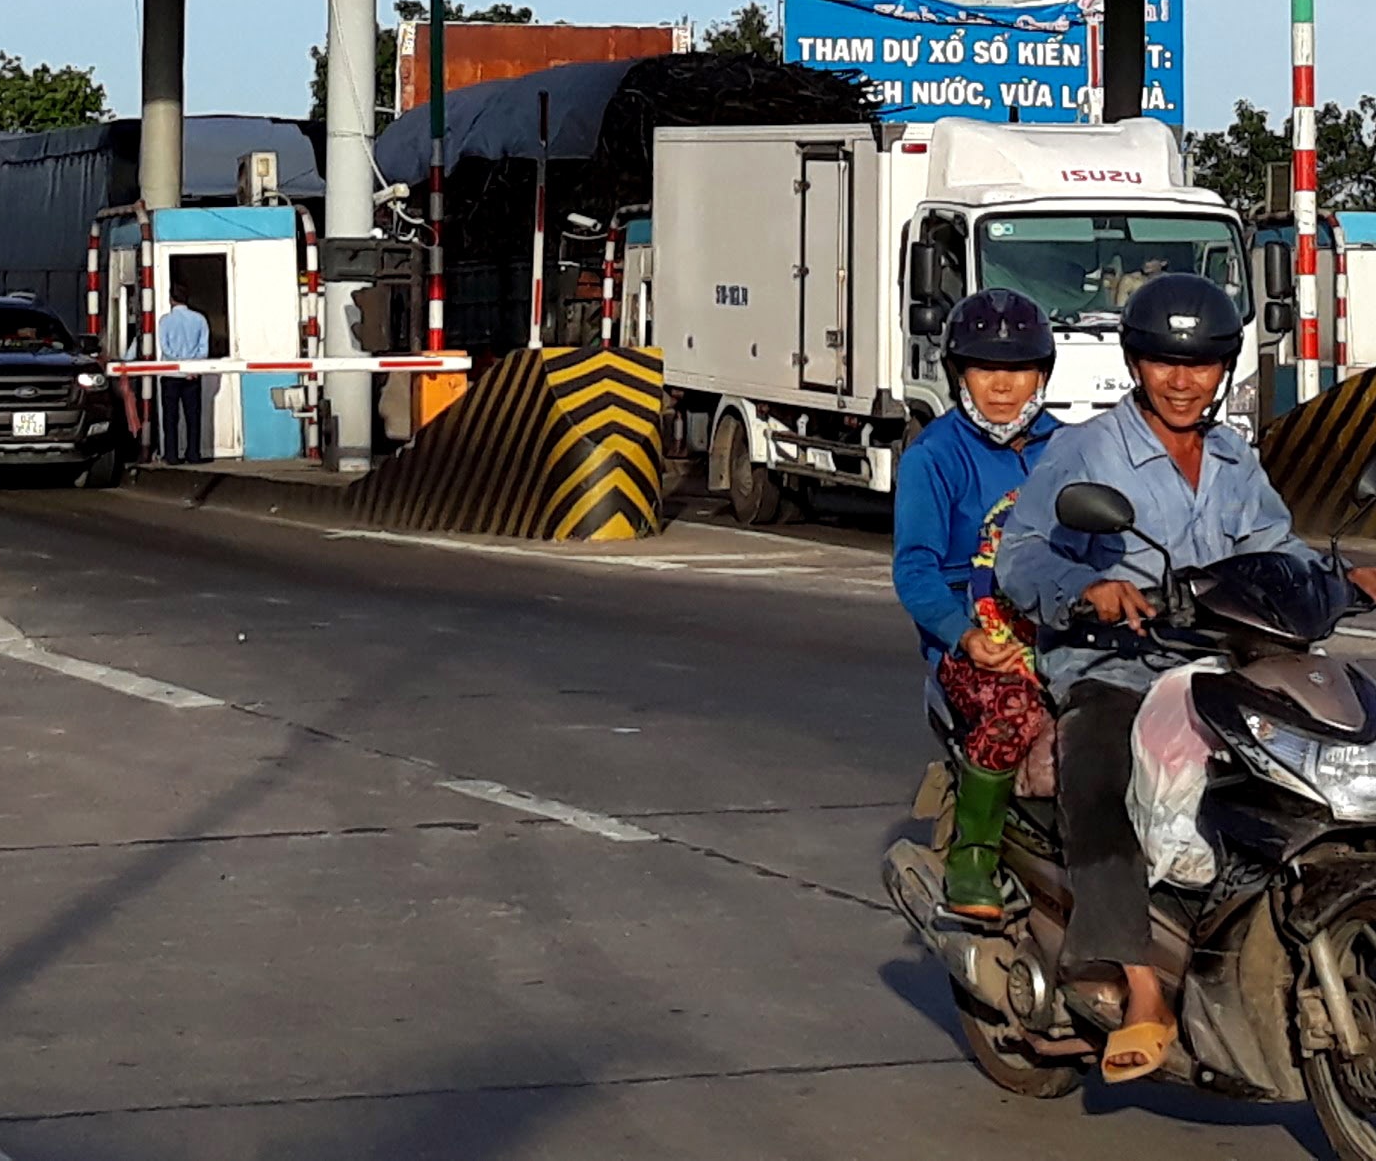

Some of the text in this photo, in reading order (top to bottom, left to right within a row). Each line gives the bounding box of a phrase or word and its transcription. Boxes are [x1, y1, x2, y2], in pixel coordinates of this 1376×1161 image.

[798, 36, 874, 63] THAM
[882, 34, 922, 67] DỰ
[928, 27, 967, 64] XỔ
[972, 31, 1009, 65] SỐ
[1017, 35, 1081, 67] KIẾN
[911, 76, 992, 109] NƯỚC,
[999, 75, 1054, 109] VỪA
[1060, 170, 1142, 184] ISUZU
